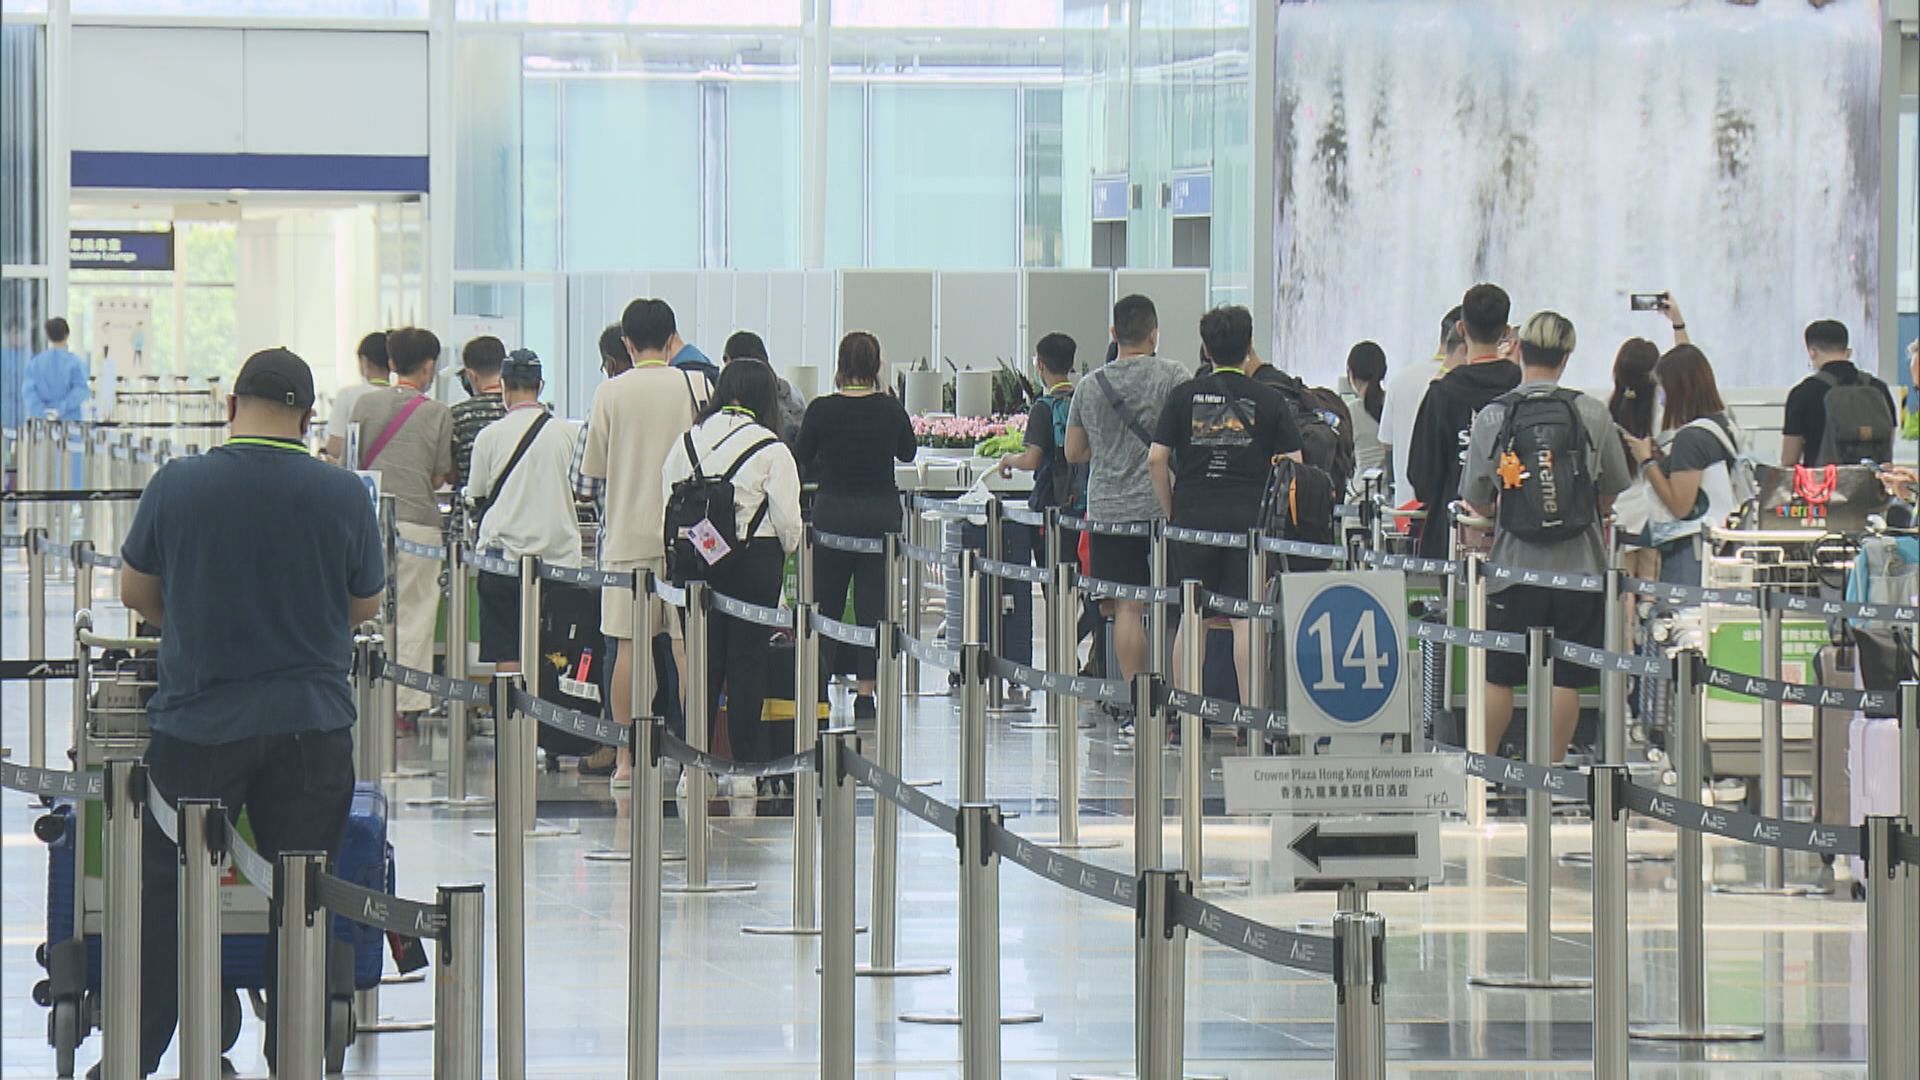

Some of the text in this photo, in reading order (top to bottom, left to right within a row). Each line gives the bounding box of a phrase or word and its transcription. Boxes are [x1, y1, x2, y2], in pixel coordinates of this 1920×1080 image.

[1307, 609, 1389, 690] 14
[1254, 765, 1434, 782] Crowne Plaza Hong Kong Kowloon East
[1281, 784, 1408, 799] 香港九龍東皇冠假日酒店
